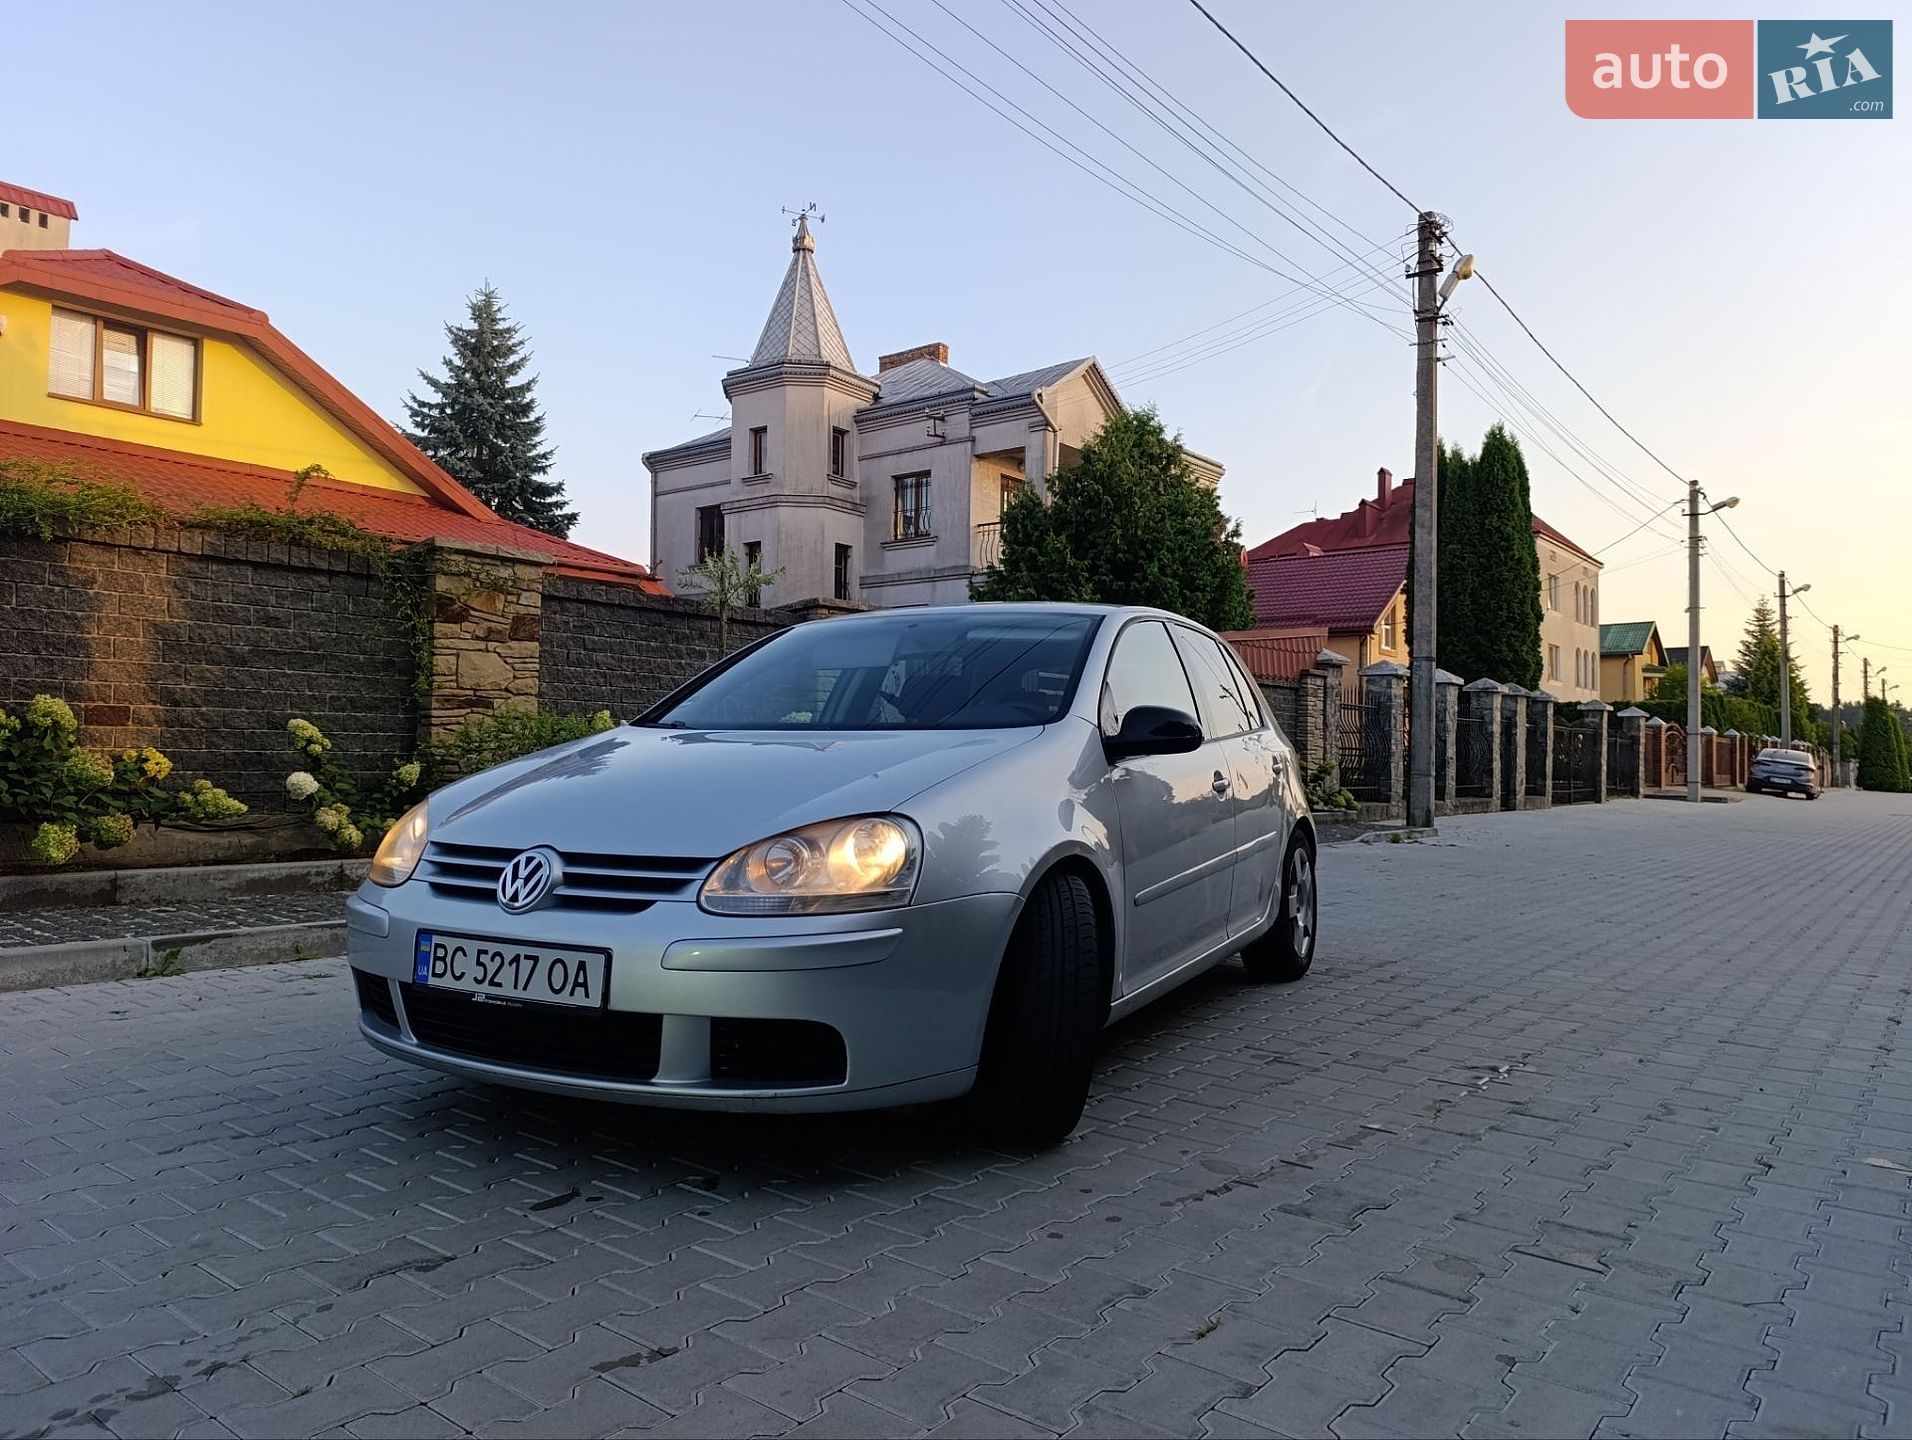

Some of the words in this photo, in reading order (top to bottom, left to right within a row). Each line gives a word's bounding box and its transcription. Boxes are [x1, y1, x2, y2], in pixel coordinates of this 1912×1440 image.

[418, 965, 428, 976] UA
[432, 943, 467, 980] BC
[474, 949, 540, 991] 5217
[547, 958, 590, 999] OA
